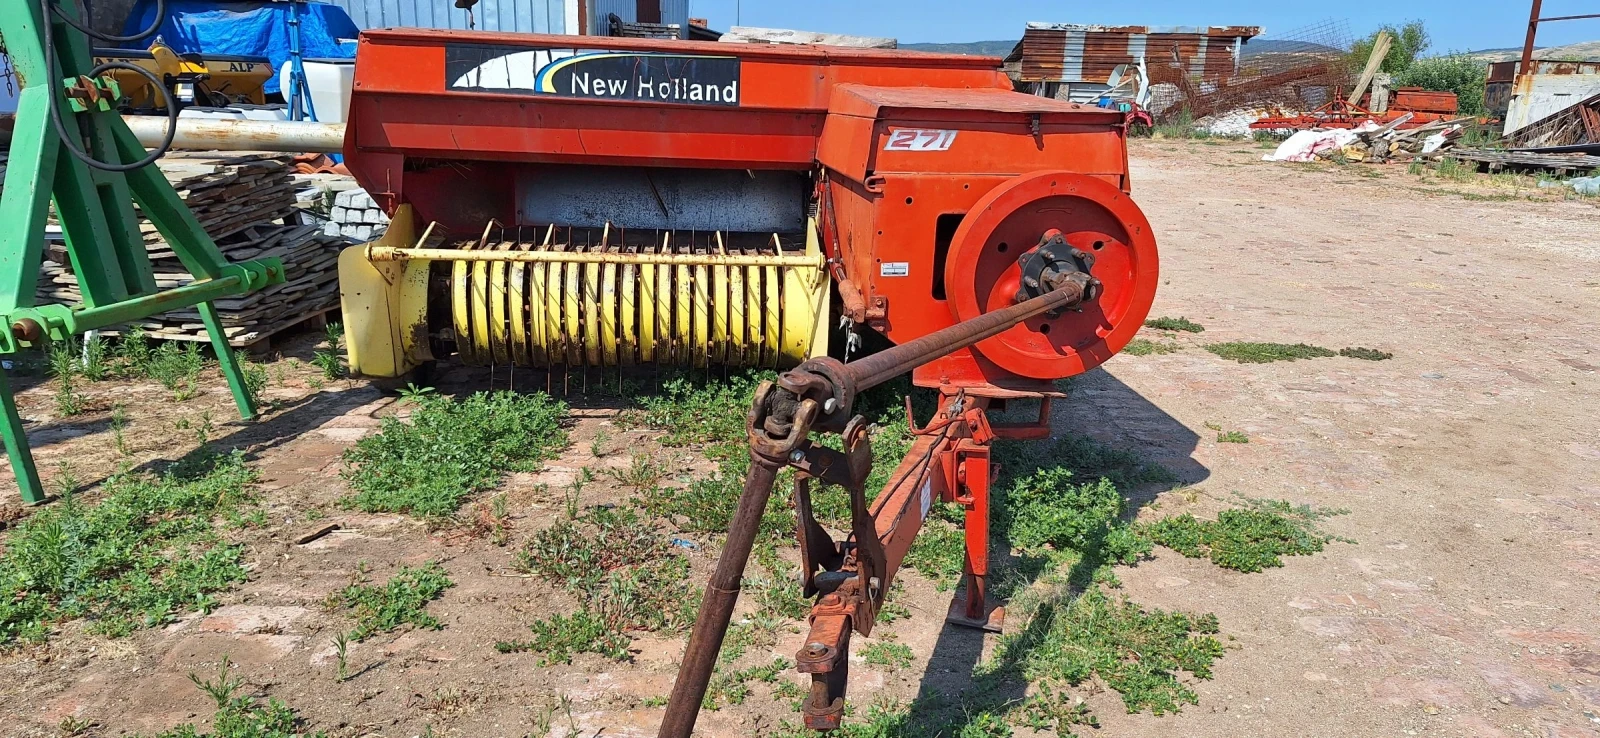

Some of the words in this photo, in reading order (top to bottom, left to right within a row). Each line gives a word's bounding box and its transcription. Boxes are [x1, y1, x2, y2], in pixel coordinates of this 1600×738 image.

[229, 62, 254, 72] ALP
[571, 72, 628, 96] New
[637, 75, 737, 103] Holland
[890, 131, 952, 149] 271
